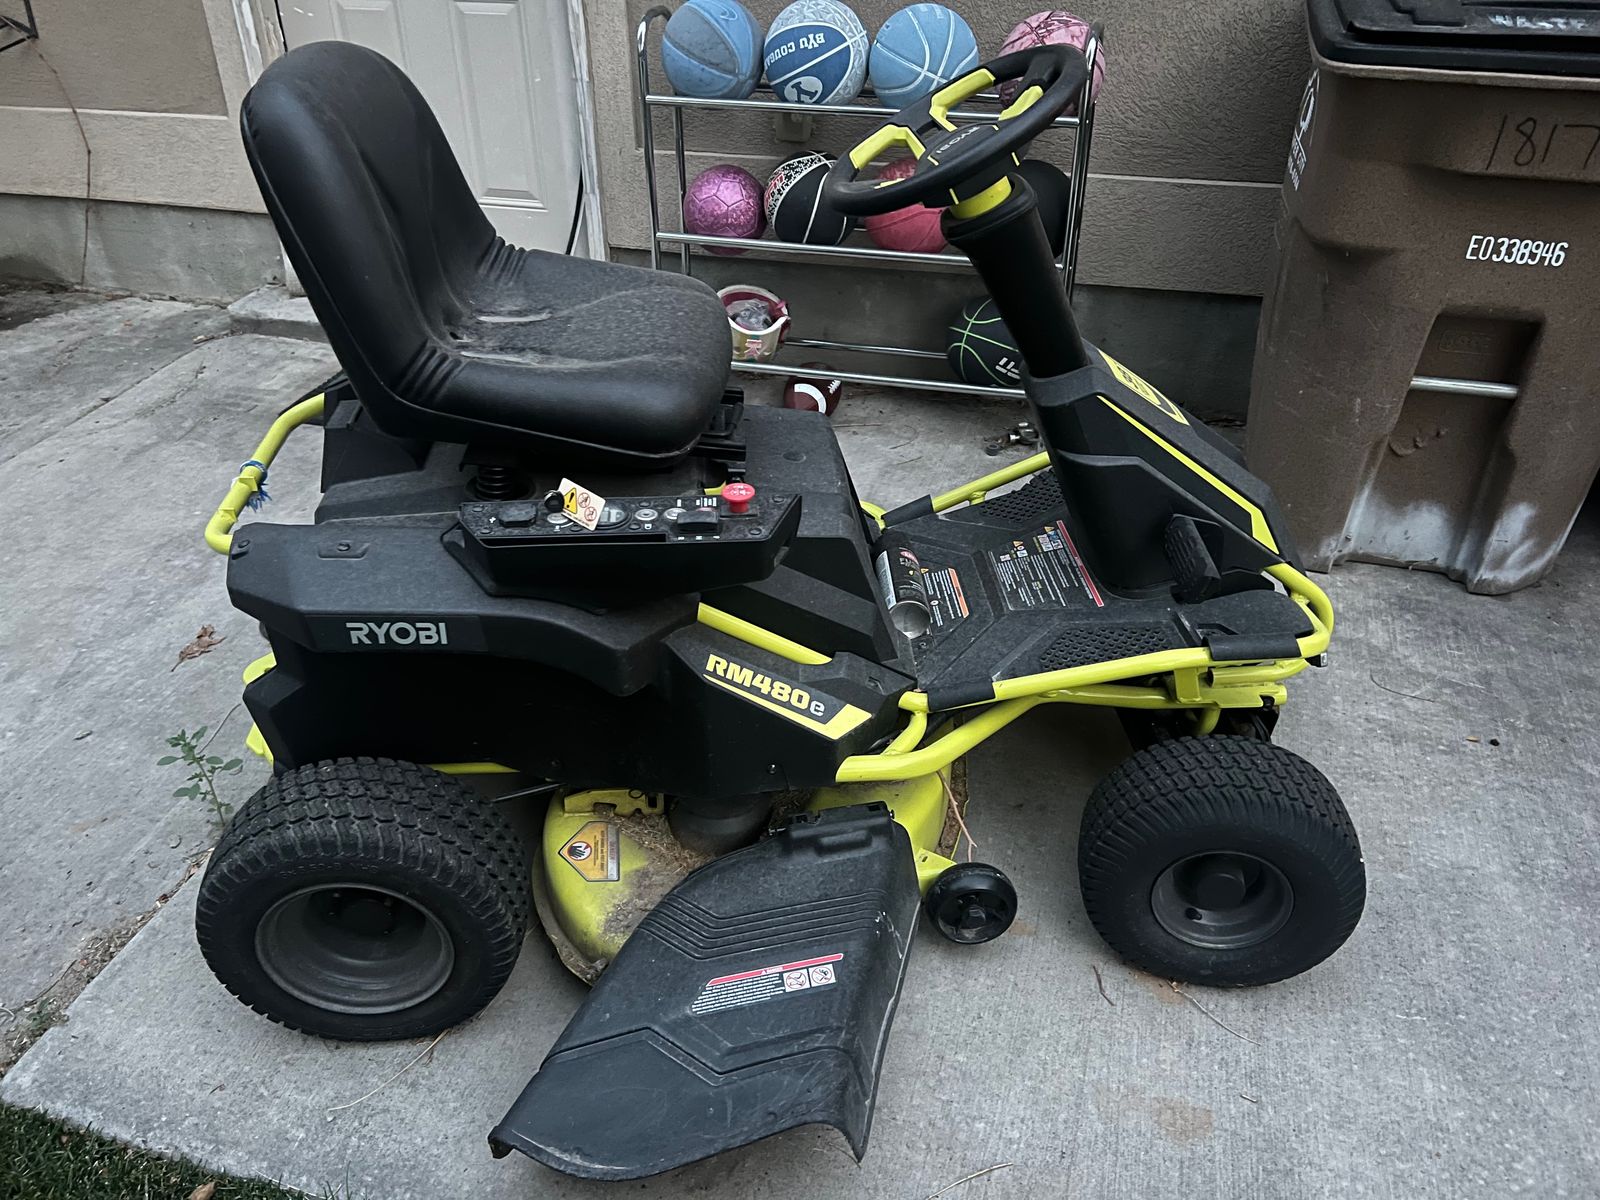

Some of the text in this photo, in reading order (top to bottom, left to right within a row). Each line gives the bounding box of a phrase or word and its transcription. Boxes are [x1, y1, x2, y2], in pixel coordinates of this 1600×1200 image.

[799, 32, 826, 50] BYU
[1486, 114, 1600, 170] 1817
[345, 621, 448, 645] RYOBI
[705, 653, 826, 717] RM480e
